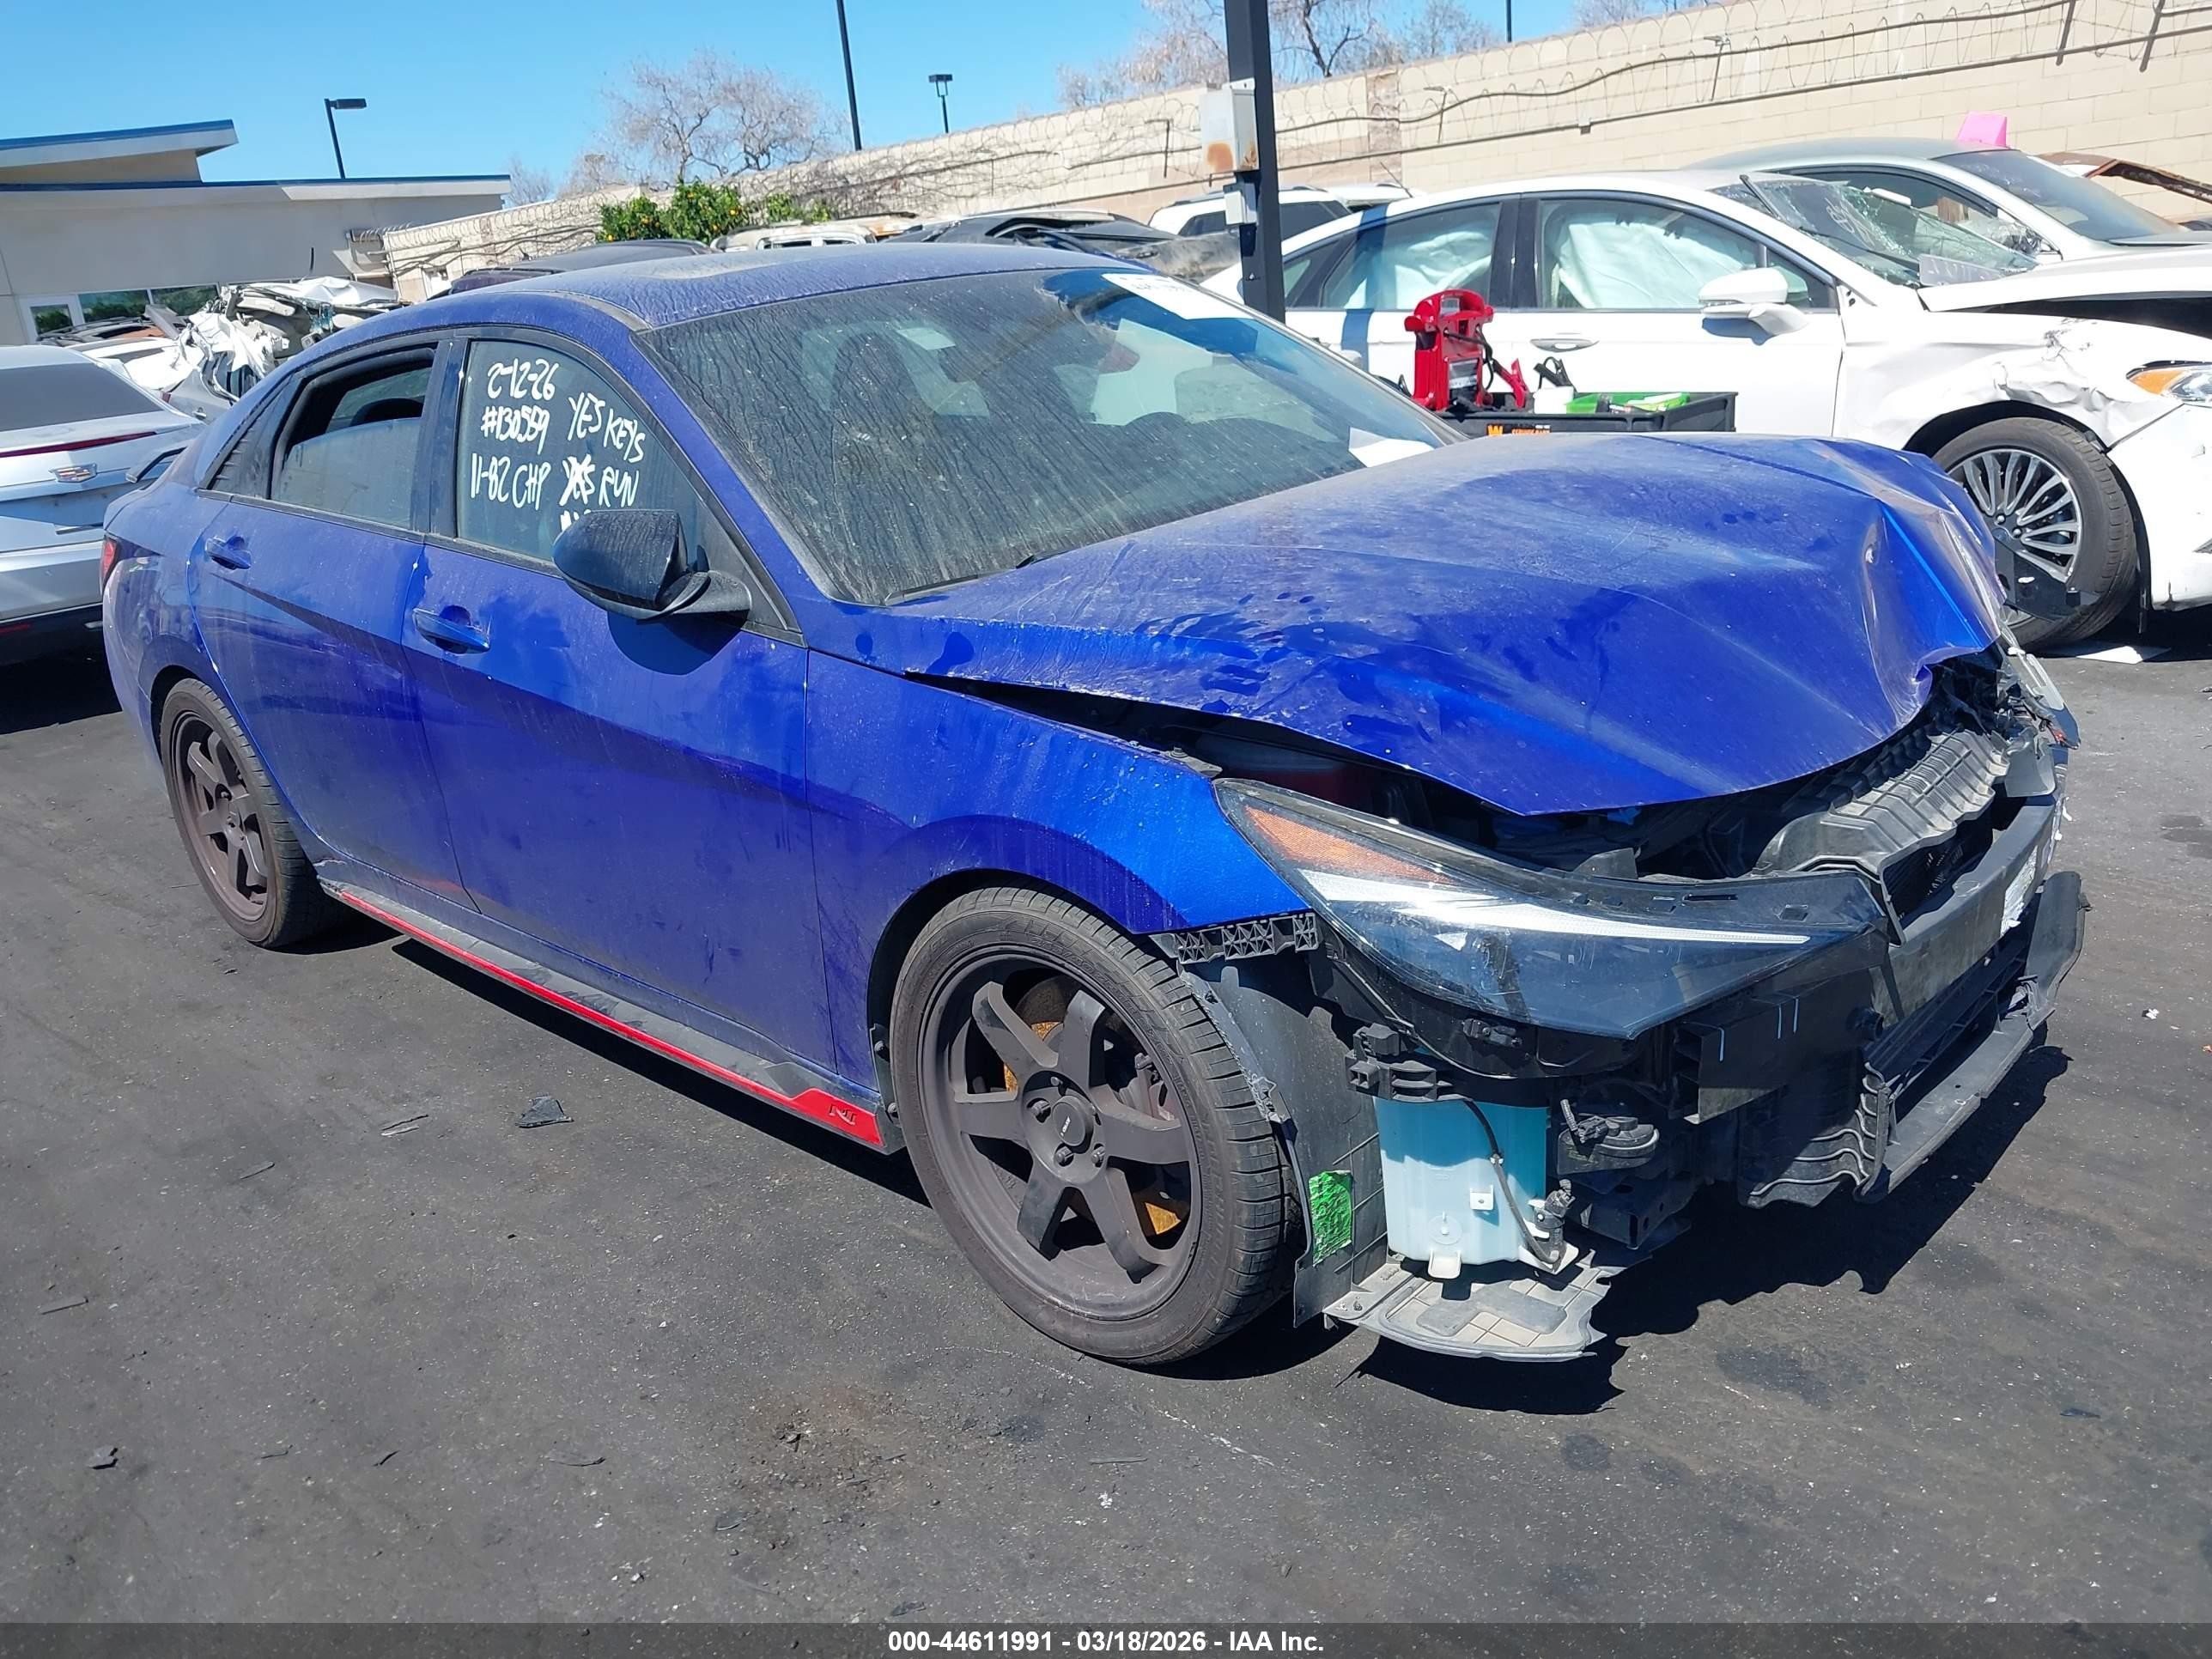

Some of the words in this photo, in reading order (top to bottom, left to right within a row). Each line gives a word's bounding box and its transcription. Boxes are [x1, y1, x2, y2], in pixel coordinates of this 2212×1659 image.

[567, 392, 605, 441] YES
[603, 408, 646, 464] KEYS
[512, 461, 551, 511] CHP
[599, 466, 640, 507] RUN
